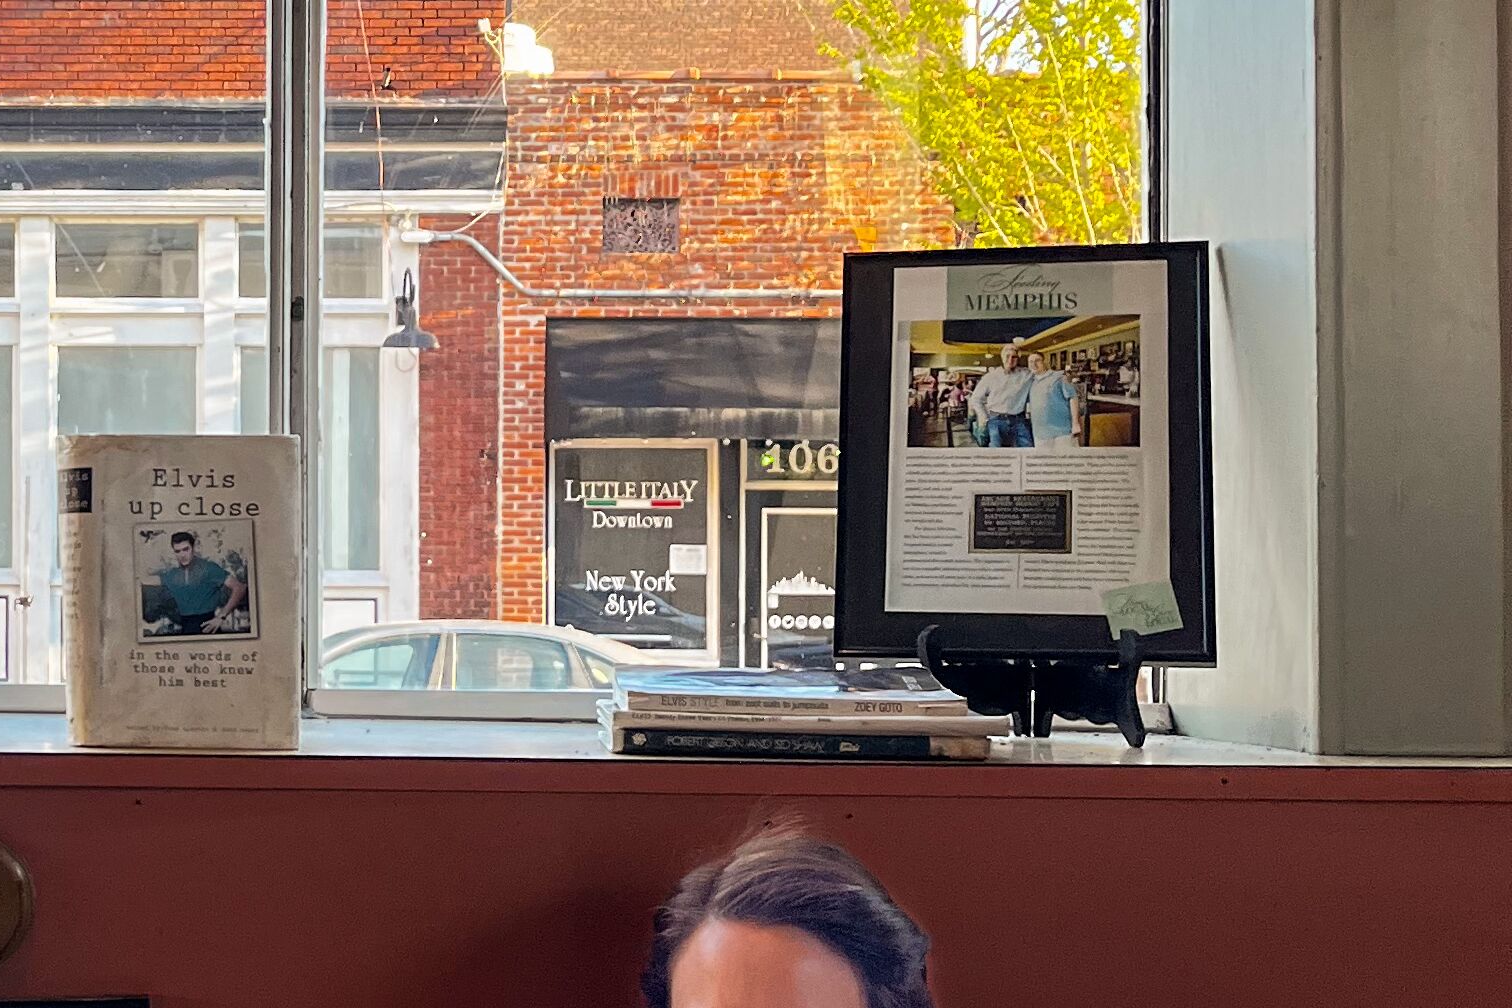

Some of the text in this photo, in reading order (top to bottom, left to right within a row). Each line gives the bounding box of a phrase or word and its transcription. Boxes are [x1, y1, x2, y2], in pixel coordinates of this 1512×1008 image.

[965, 292, 1078, 311] MEMPHIS
[765, 442, 838, 473] 106
[152, 468, 235, 489] Elvis
[564, 480, 698, 502] LITTLE ITALY
[129, 497, 260, 520] up close
[592, 510, 673, 529] Downtown
[585, 570, 676, 592] New York
[604, 593, 656, 622] Style
[128, 649, 258, 662] in the words of
[133, 662, 254, 674] those who knew
[158, 676, 227, 688] him best
[662, 696, 687, 707] ELVIS
[855, 702, 878, 712] ZOEY
[878, 702, 903, 713] GOTO
